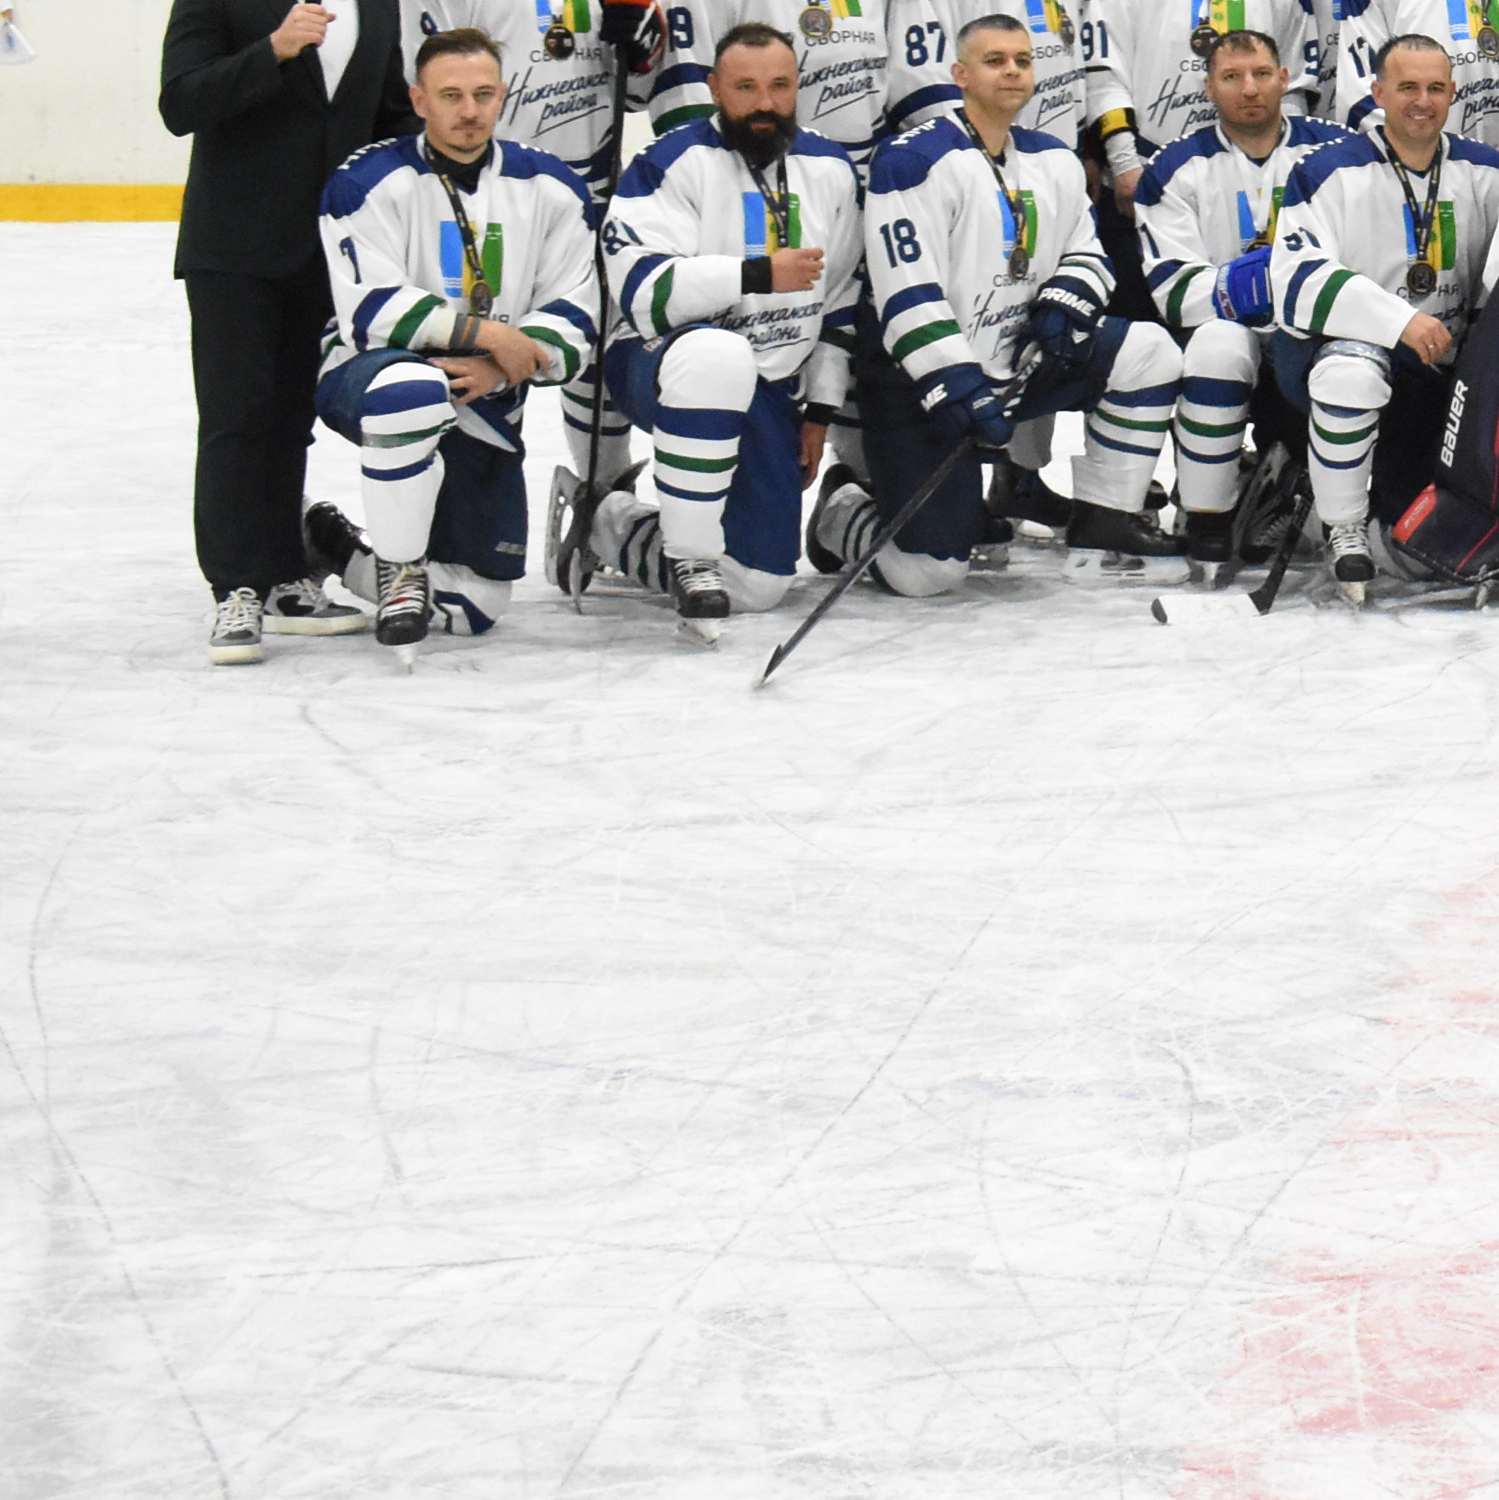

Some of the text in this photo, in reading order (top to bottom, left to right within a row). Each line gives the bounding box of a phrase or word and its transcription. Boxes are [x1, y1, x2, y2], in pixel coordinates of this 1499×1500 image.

[904, 20, 947, 68] 87
[879, 217, 923, 269] 18
[1040, 286, 1097, 318] PRIME
